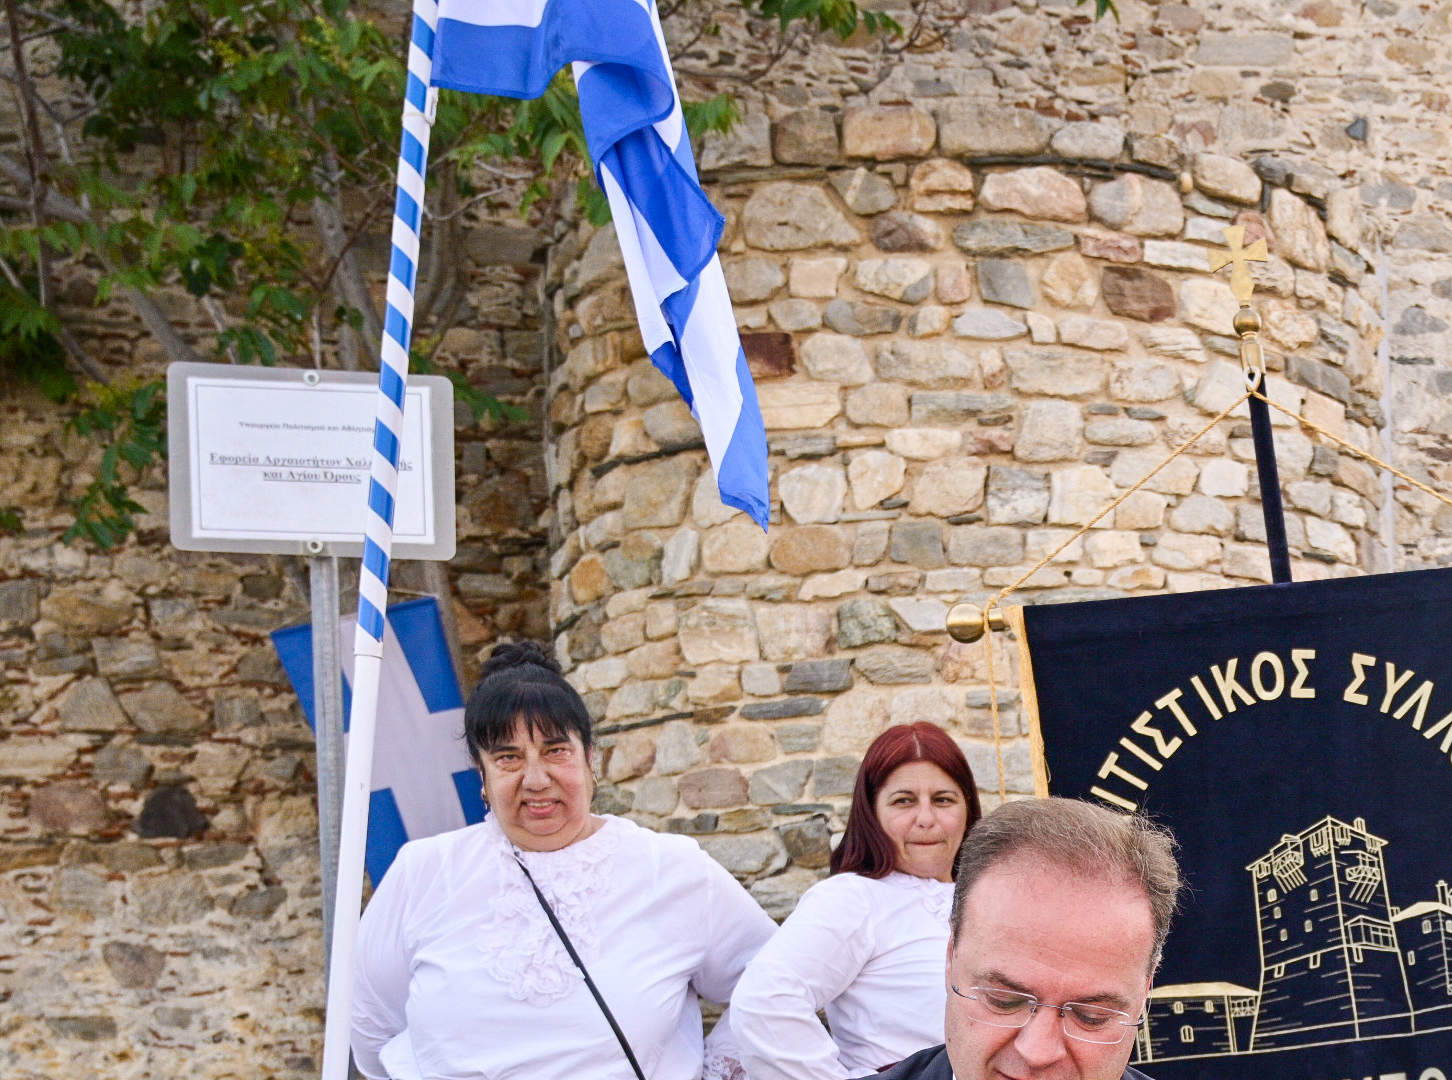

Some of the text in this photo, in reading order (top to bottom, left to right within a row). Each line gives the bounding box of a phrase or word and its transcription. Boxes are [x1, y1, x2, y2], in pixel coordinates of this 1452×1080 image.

[209, 452, 260, 466] Εφορεία
[263, 454, 341, 468] Αρχαιοτήτων
[263, 470, 362, 484] και Αγίου Όρους
[1090, 648, 1316, 812] ΙΤΙΣΤΙΚΟΣ
